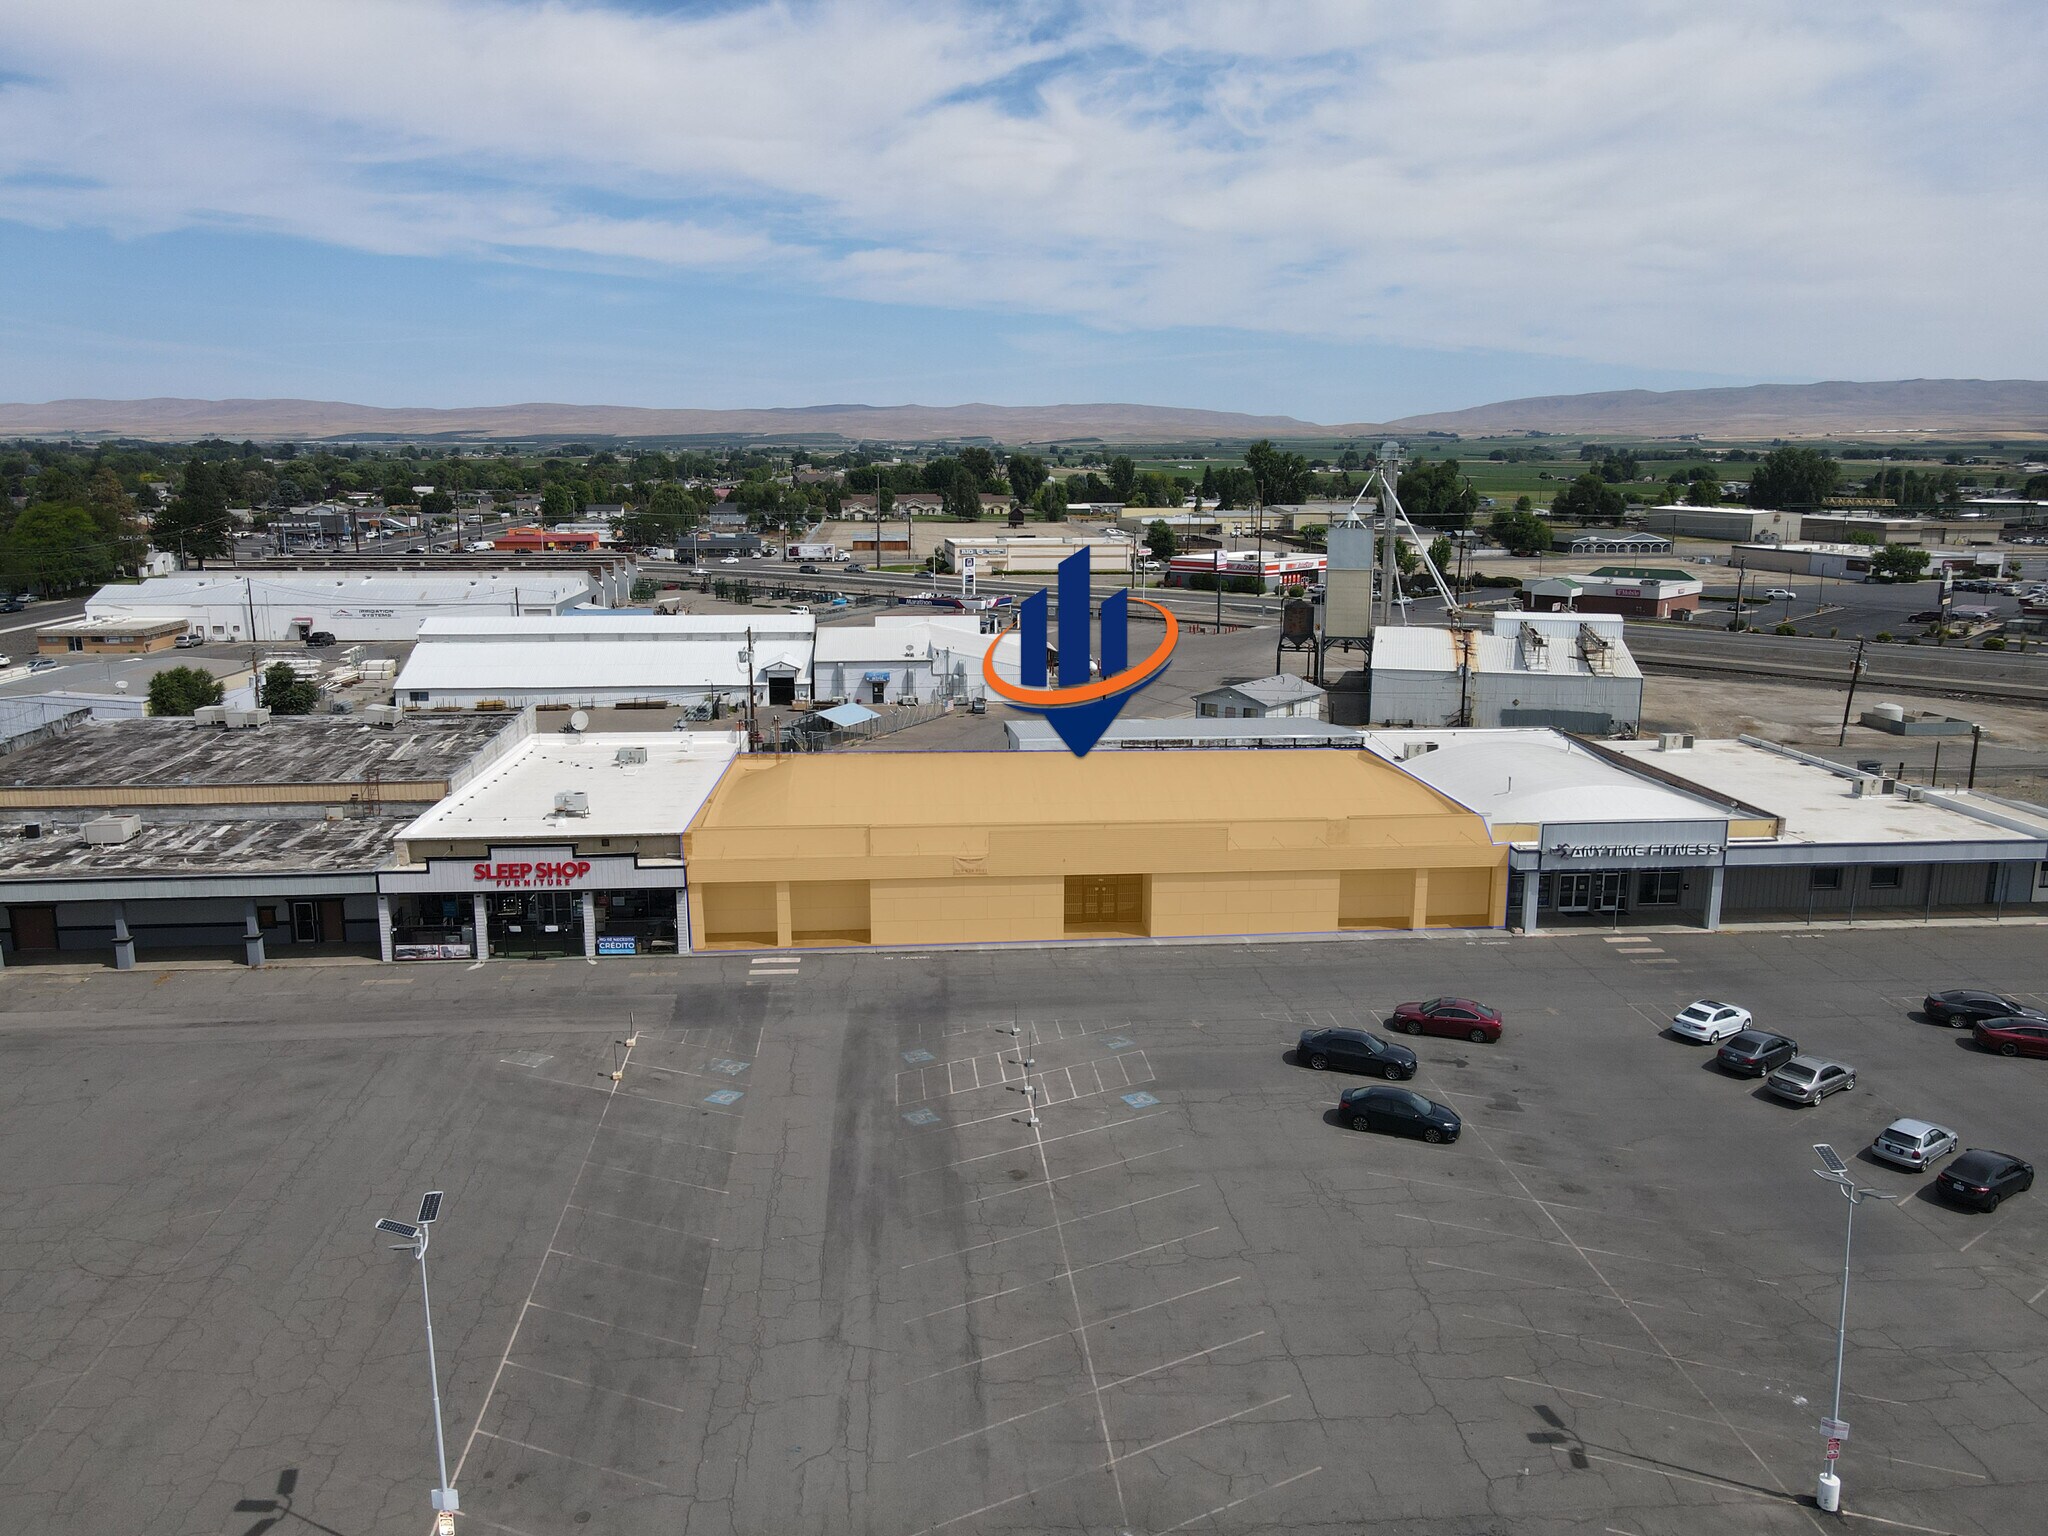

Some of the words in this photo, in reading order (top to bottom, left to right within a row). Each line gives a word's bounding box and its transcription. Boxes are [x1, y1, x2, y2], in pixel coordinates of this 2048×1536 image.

[905, 598, 933, 606] Marathon
[1571, 846, 1645, 858] ANYTIME
[1649, 844, 1720, 856] FITNESS
[473, 863, 533, 880] SLEEP
[535, 861, 591, 879] SHOP
[496, 879, 571, 888] FURNITURE
[599, 941, 635, 949] CRÉDITO
